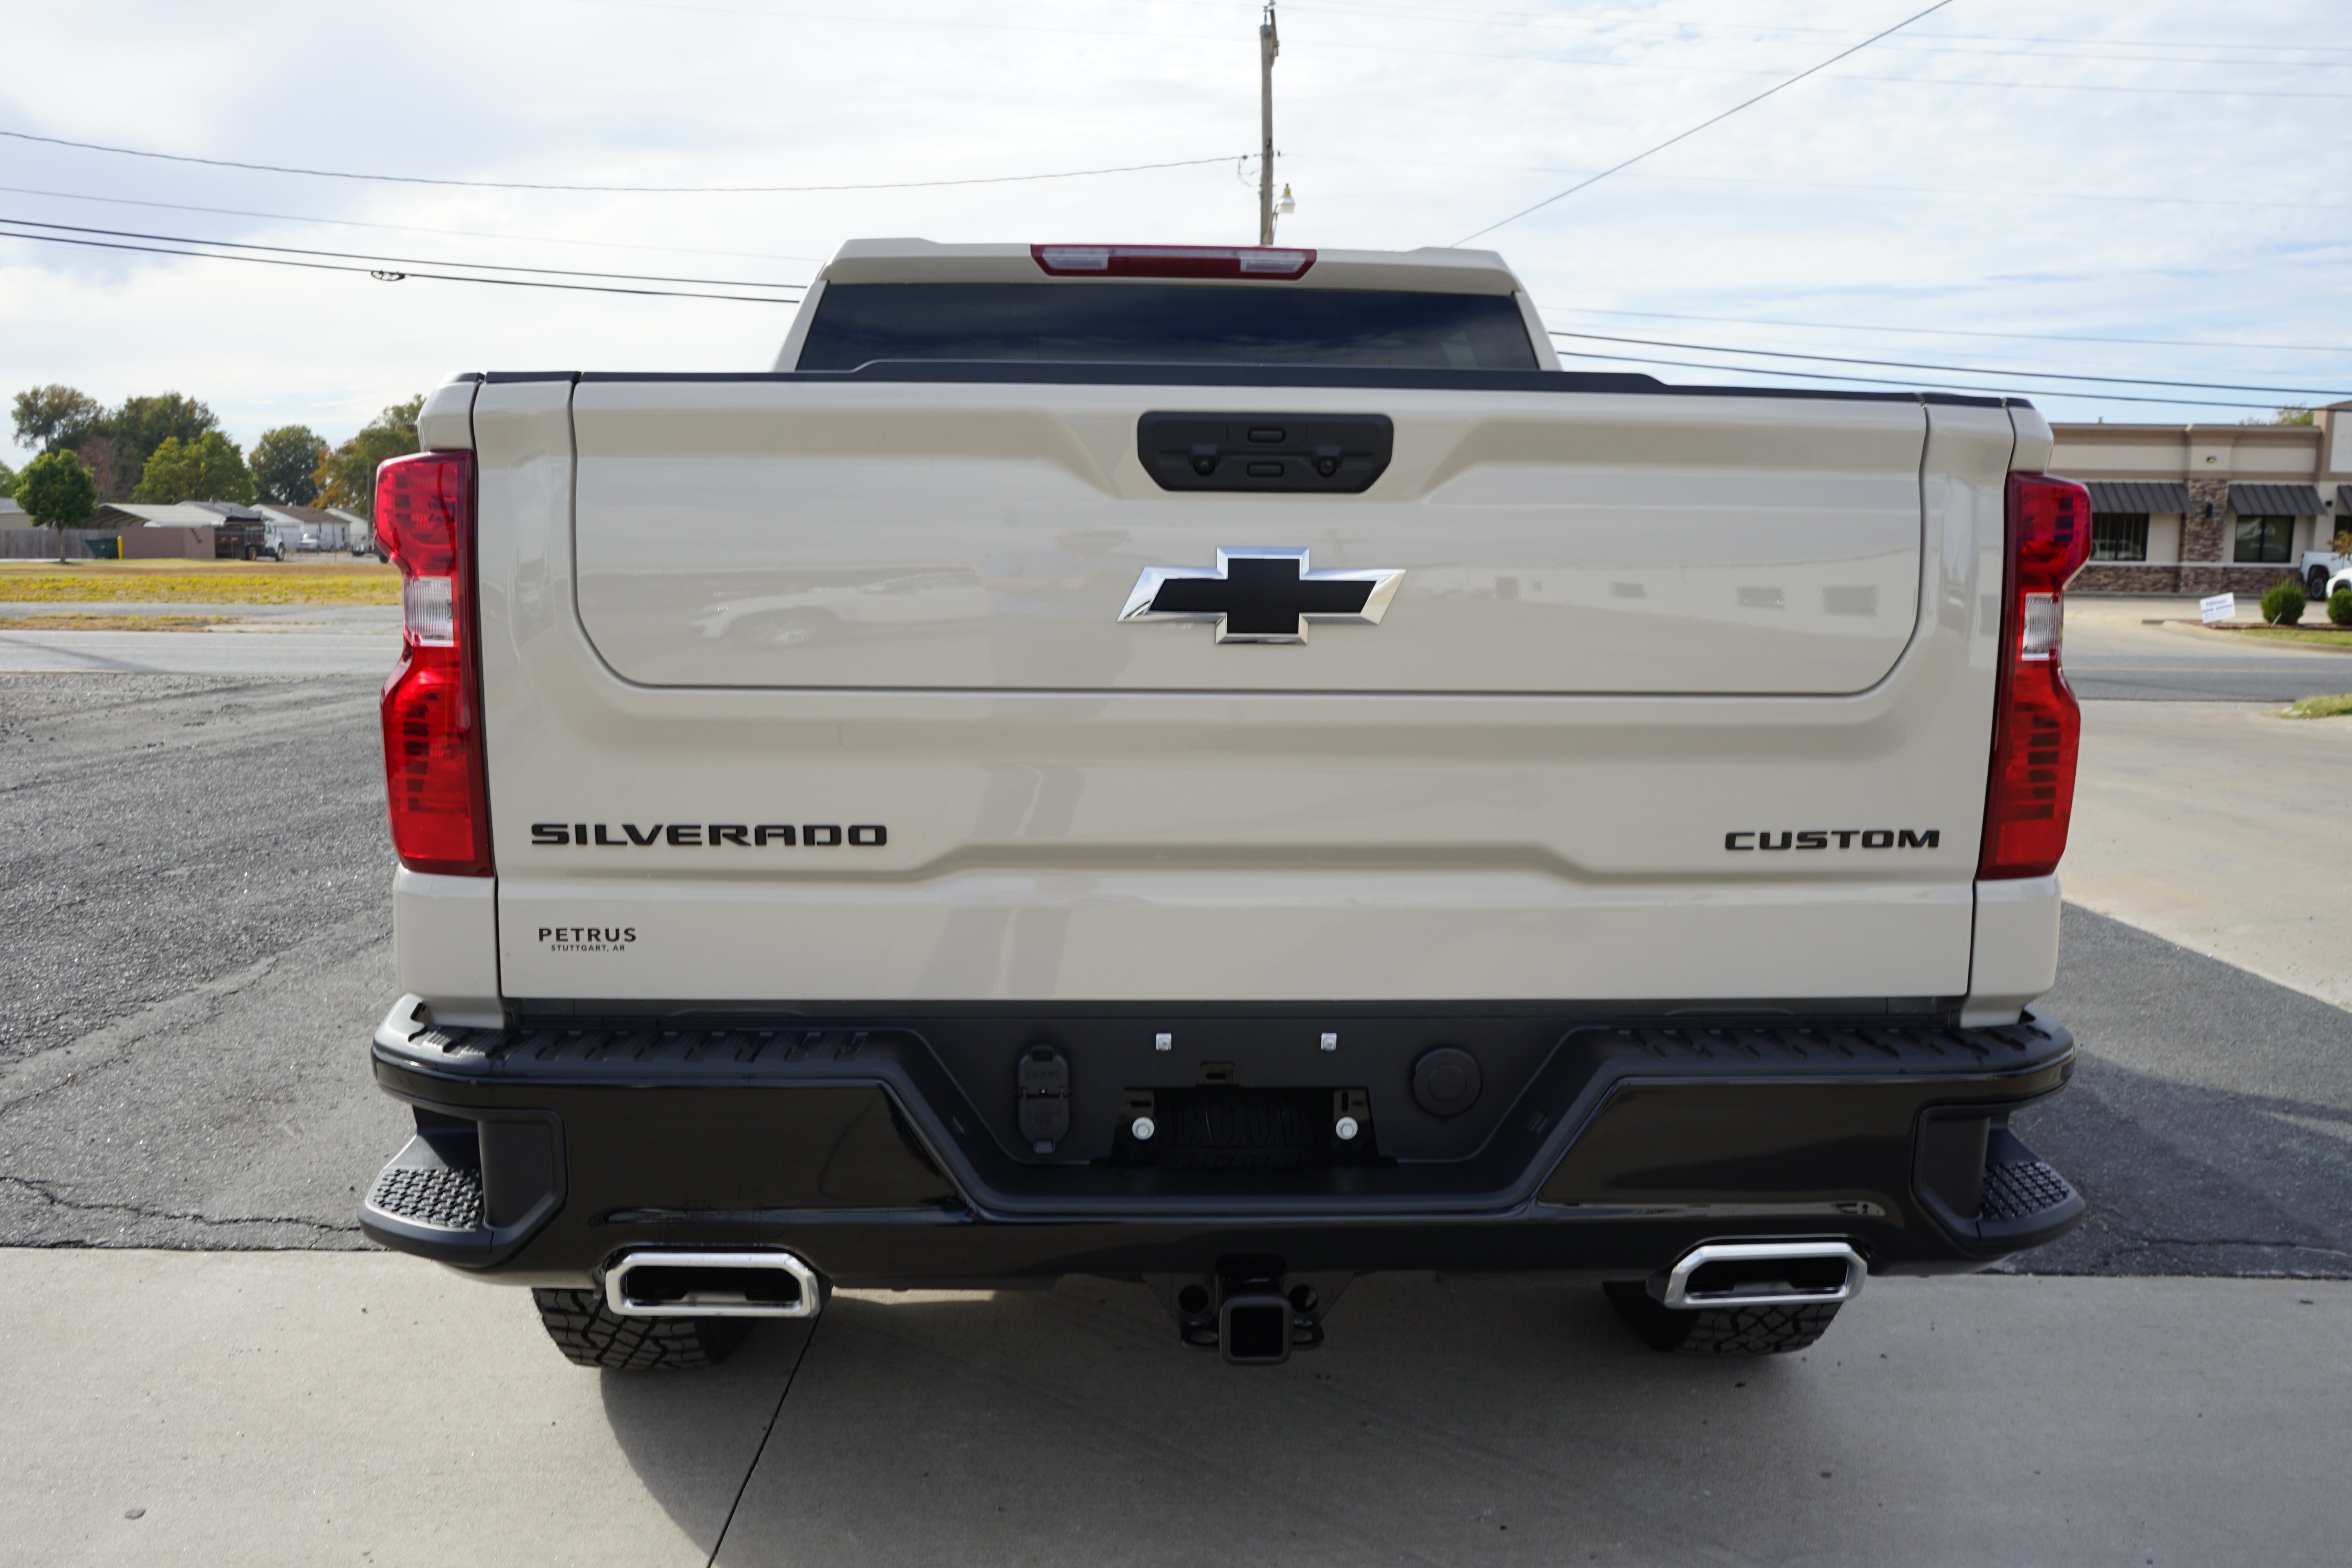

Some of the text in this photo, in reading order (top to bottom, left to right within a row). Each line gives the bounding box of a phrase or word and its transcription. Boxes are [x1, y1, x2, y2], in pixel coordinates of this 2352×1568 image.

[531, 823, 887, 846] SILVERADO
[1725, 829, 1940, 850] CUSTOM
[539, 927, 636, 942] PETRUS
